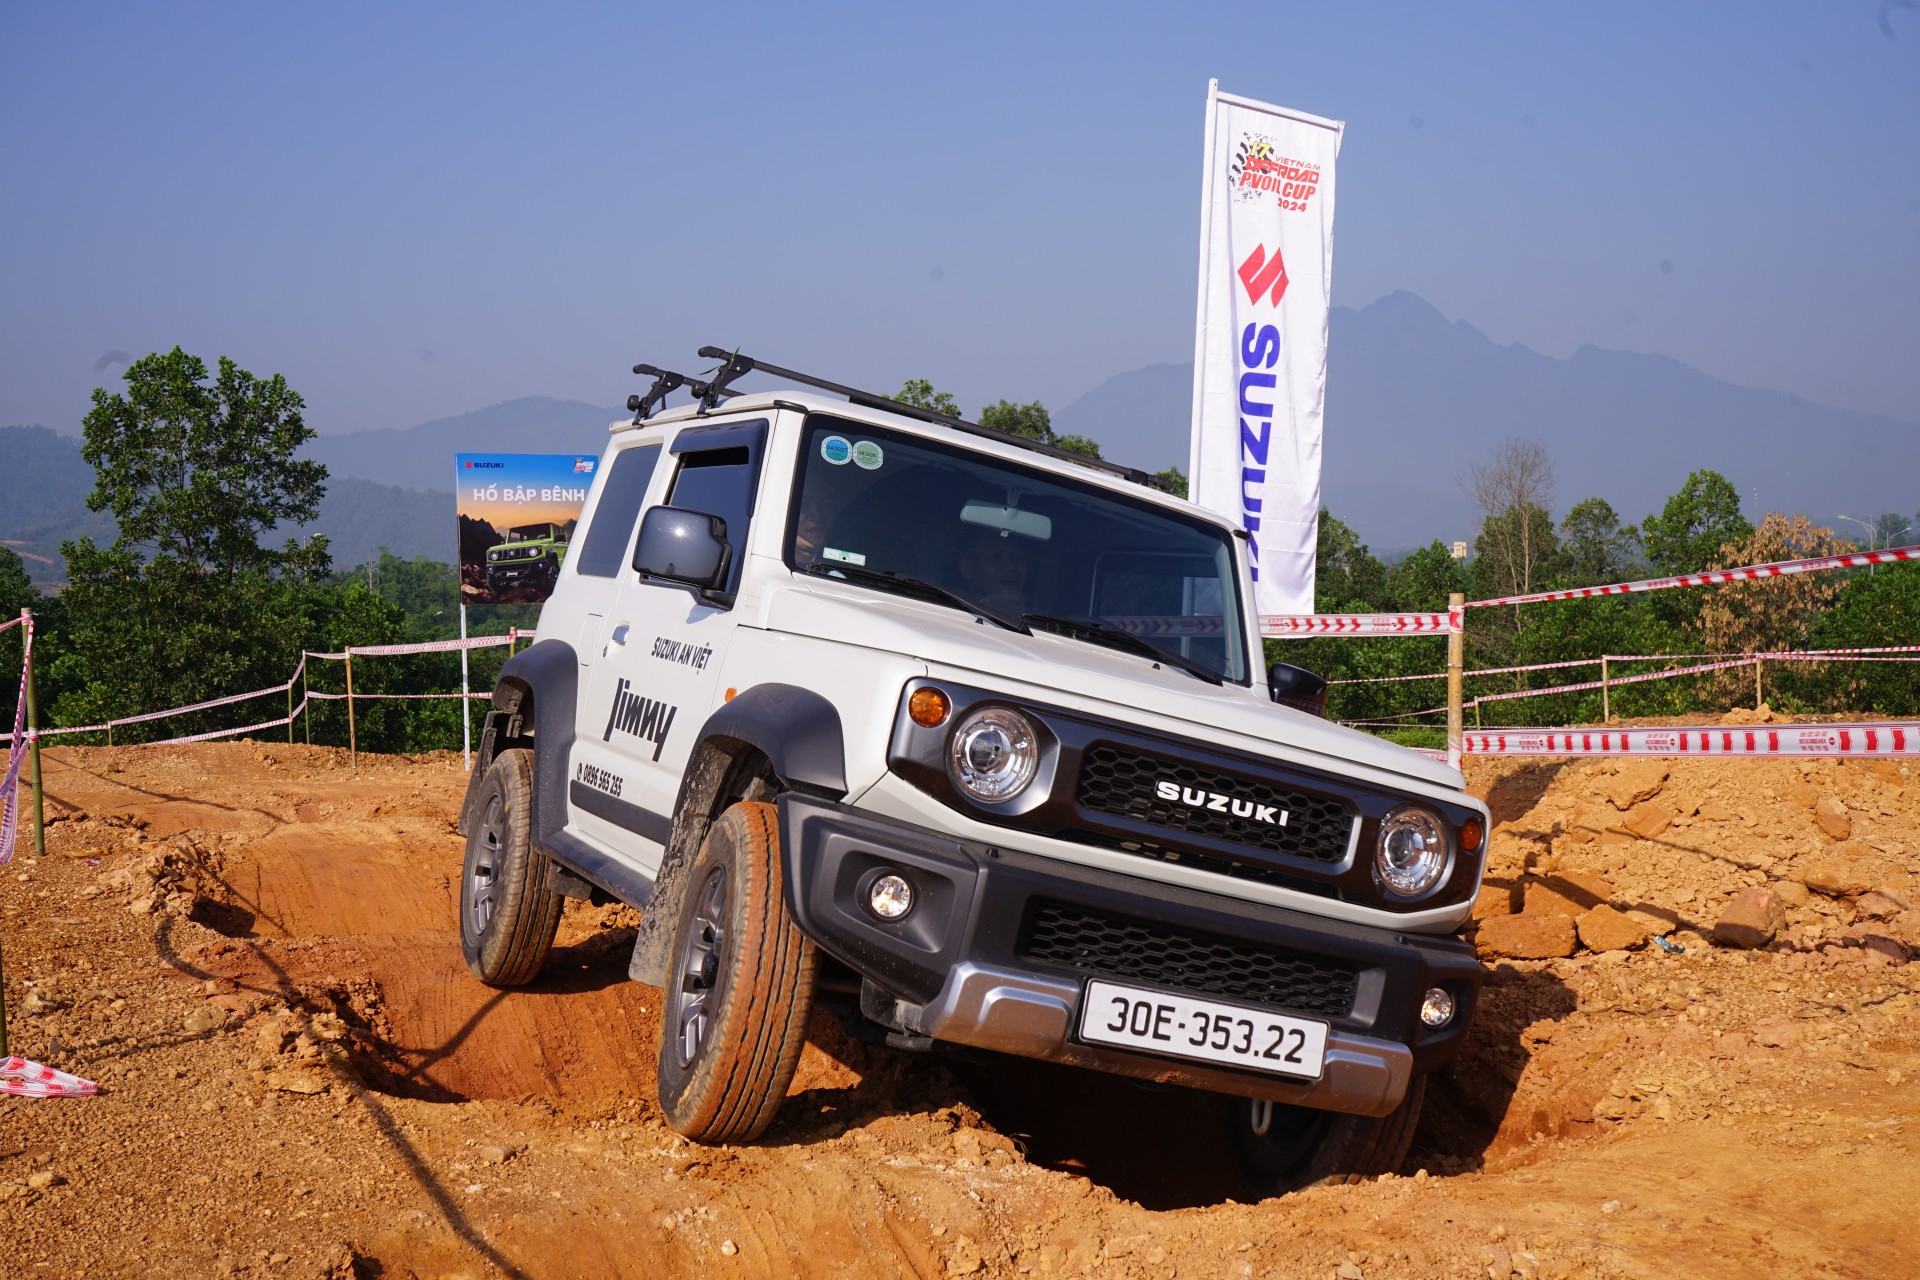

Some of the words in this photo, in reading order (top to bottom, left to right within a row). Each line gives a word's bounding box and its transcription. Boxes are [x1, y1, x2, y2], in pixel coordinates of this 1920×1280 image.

[1250, 141, 1271, 158] 17
[1245, 156, 1320, 184] OFFROAD
[1275, 155, 1320, 171] VIETNAM
[1282, 182, 1316, 201] CUP
[1277, 197, 1307, 212] 2024
[473, 483, 498, 502] HỐ
[503, 485, 537, 505] BẬP
[541, 485, 585, 502] BÊNH
[651, 636, 681, 662] SUZUKI
[676, 643, 694, 666] AN
[690, 641, 713, 675] VIỆT
[583, 763, 600, 787] 0896
[598, 769, 612, 792] 565
[609, 774, 624, 798] 255
[1155, 780, 1290, 827] SUZUKI
